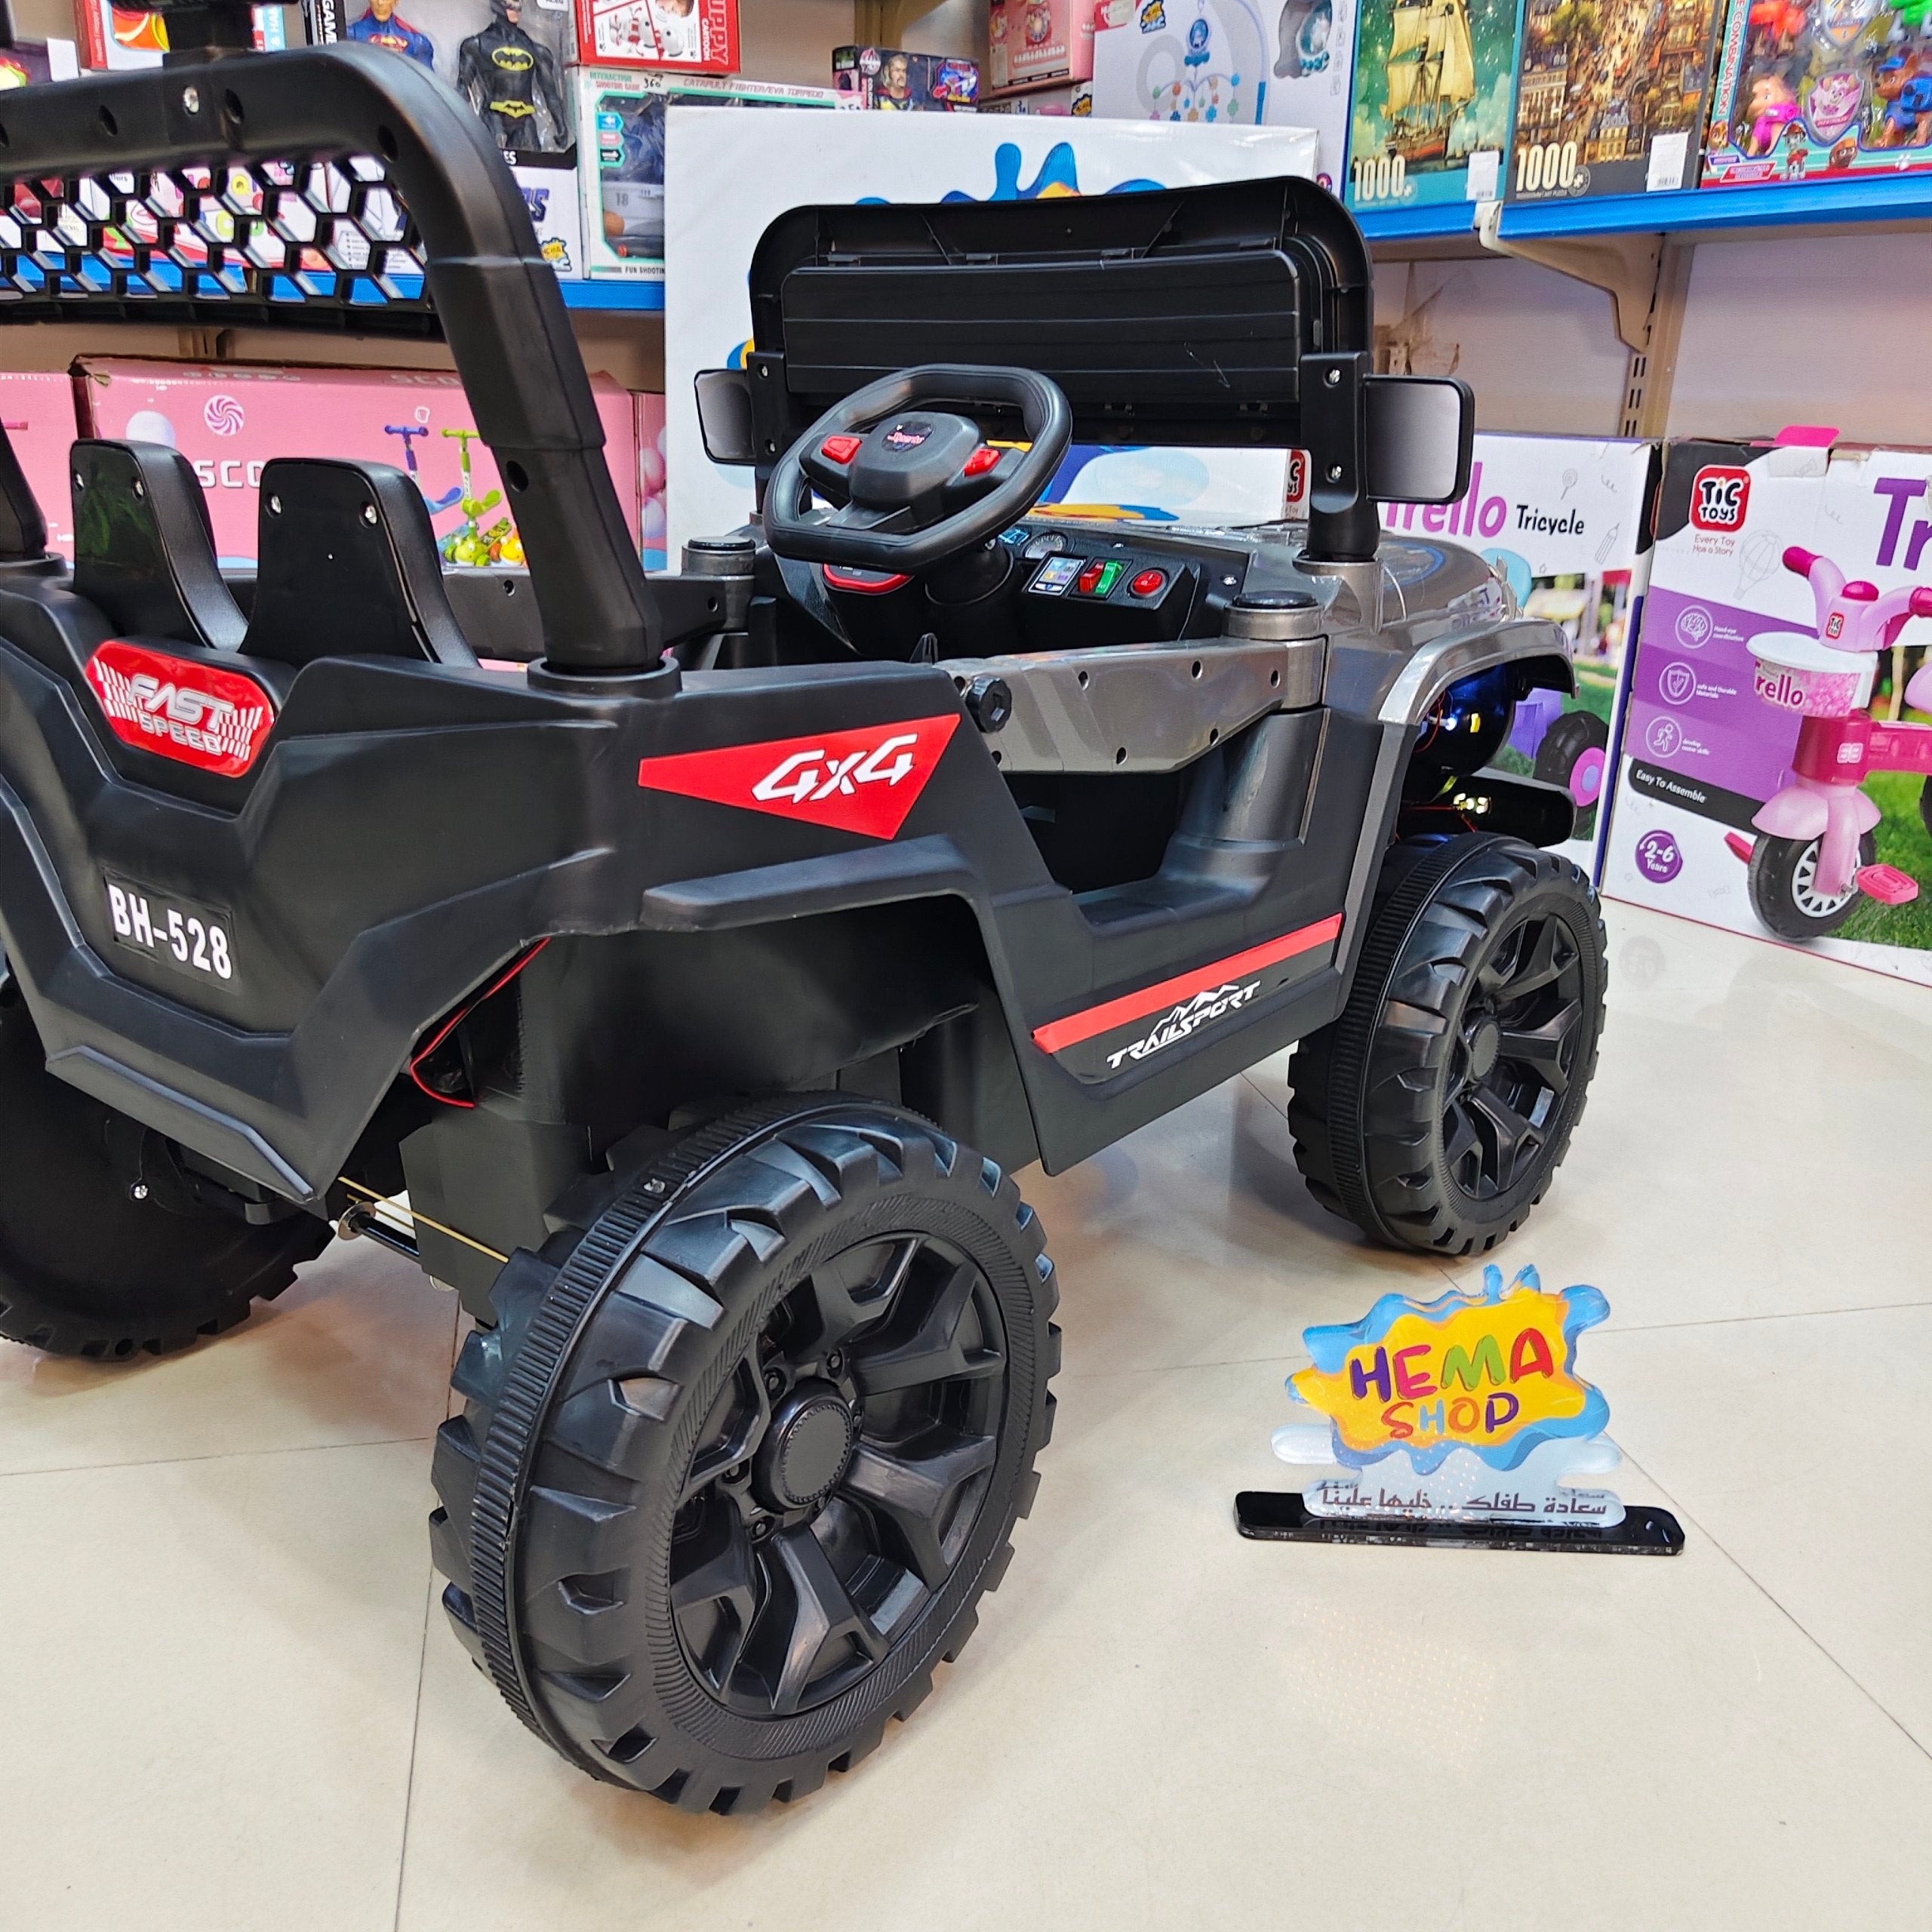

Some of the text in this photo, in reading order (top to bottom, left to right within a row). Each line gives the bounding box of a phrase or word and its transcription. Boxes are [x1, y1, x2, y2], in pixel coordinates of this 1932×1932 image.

[700, 18, 711, 61] CARTOON
[1354, 154, 1406, 202] 1000
[1516, 140, 1578, 192] 1000
[1516, 504, 1585, 536] Tricycle
[1693, 544, 1706, 554] Has
[1714, 546, 1734, 556] Story
[1694, 534, 1735, 547] Every Toy
[128, 673, 235, 731] FAST
[138, 712, 223, 757] SPEED
[1636, 769, 1707, 804] Easy To Assemble
[1644, 840, 1675, 863] 2-6
[1646, 858, 1668, 874] Years
[109, 884, 232, 980] BH-528
[1106, 980, 1261, 1070] TRAILSPORT
[1349, 1327, 1555, 1404] HEMA
[1380, 1392, 1520, 1439] SHOP
[1322, 1487, 1372, 1510] علينا
[1379, 1487, 1432, 1513] خليها
[1461, 1491, 1536, 1512] طفلك
[1543, 1497, 1607, 1515] سعادة
